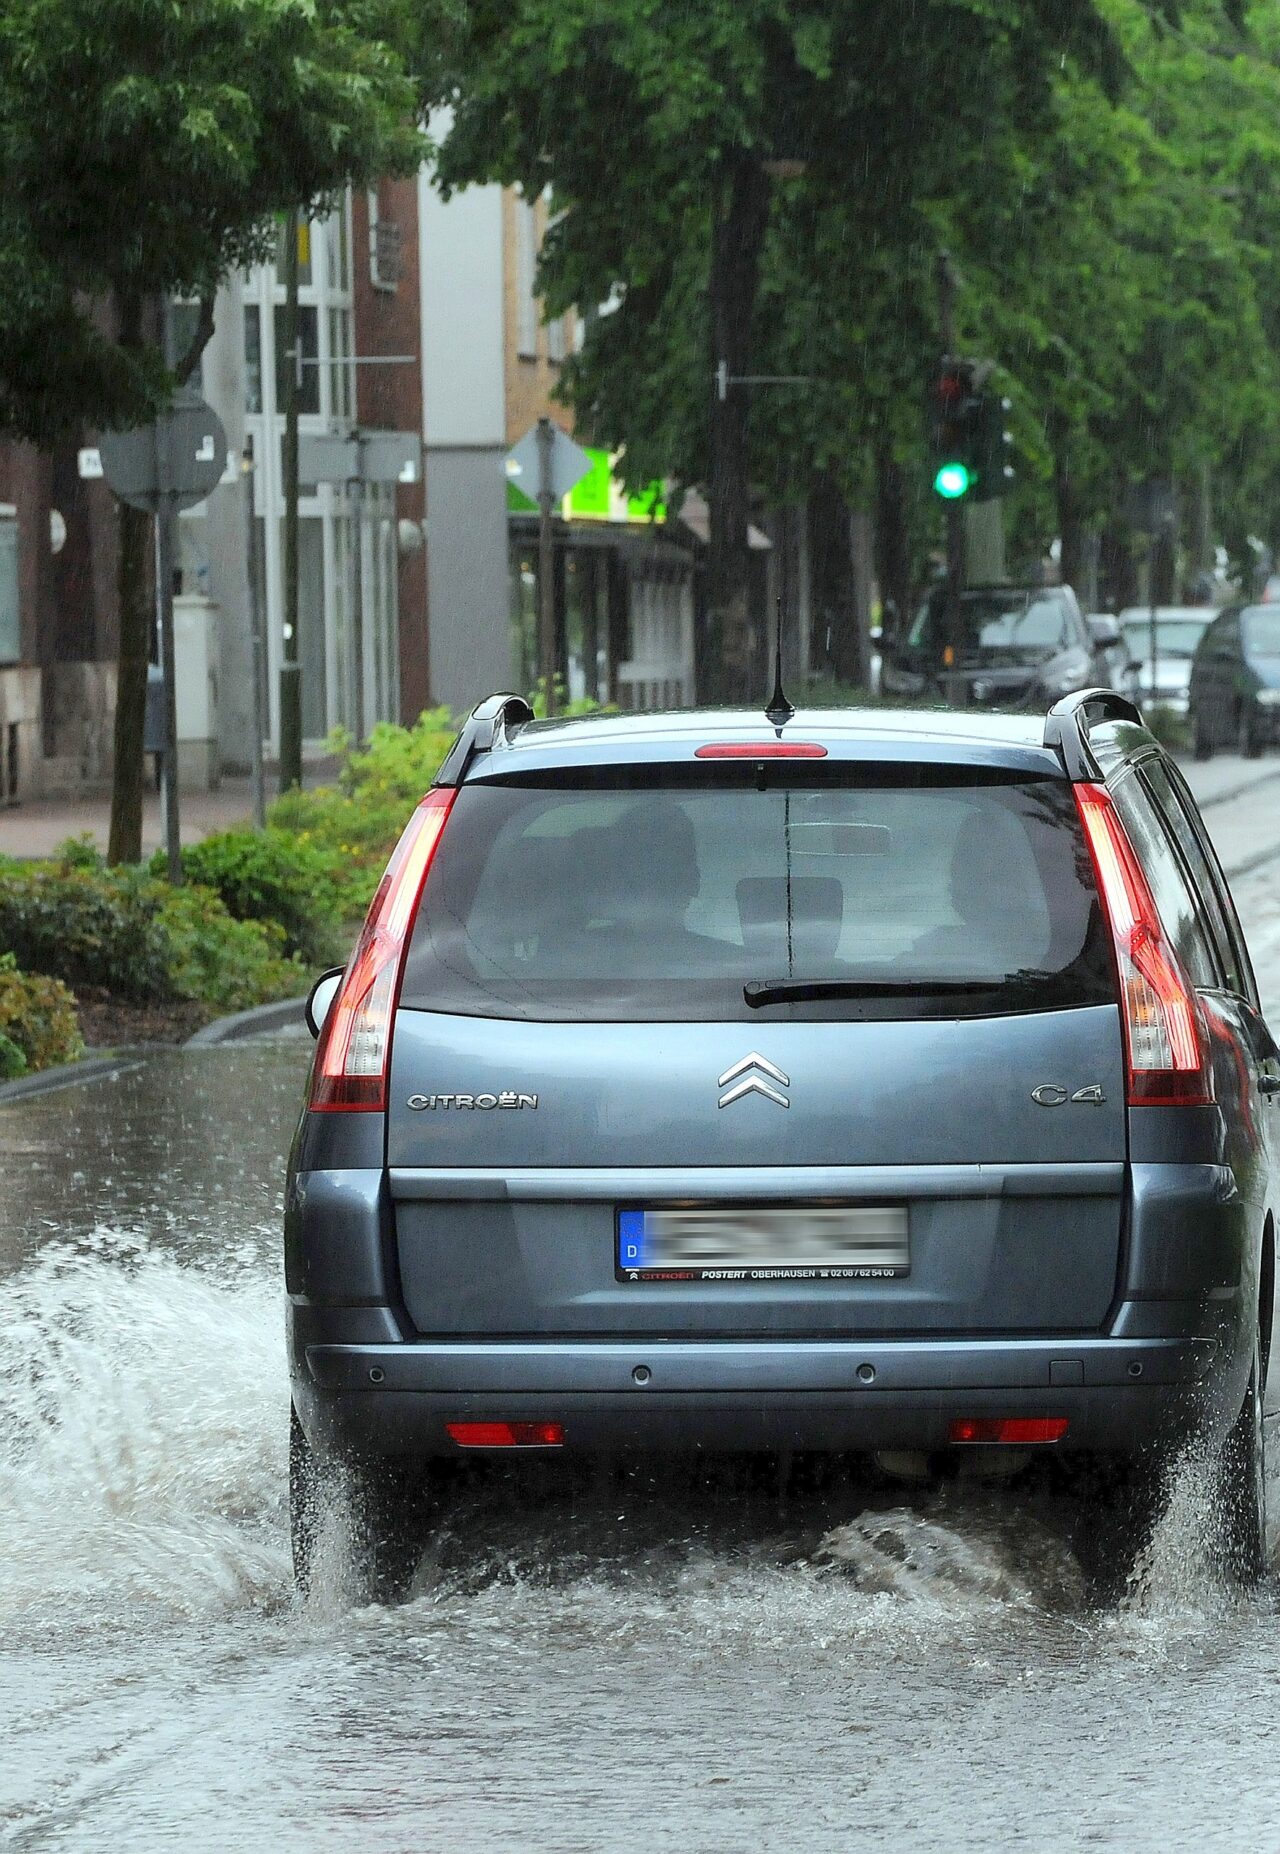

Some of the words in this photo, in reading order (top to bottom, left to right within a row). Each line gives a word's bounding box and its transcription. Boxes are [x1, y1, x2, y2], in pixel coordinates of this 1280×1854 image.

[406, 1090, 538, 1112] CITROËN
[1031, 1083, 1108, 1107] C4
[627, 1246, 637, 1258] D
[701, 1270, 747, 1279] POSTERT
[751, 1269, 816, 1278] OBERHAUSEN
